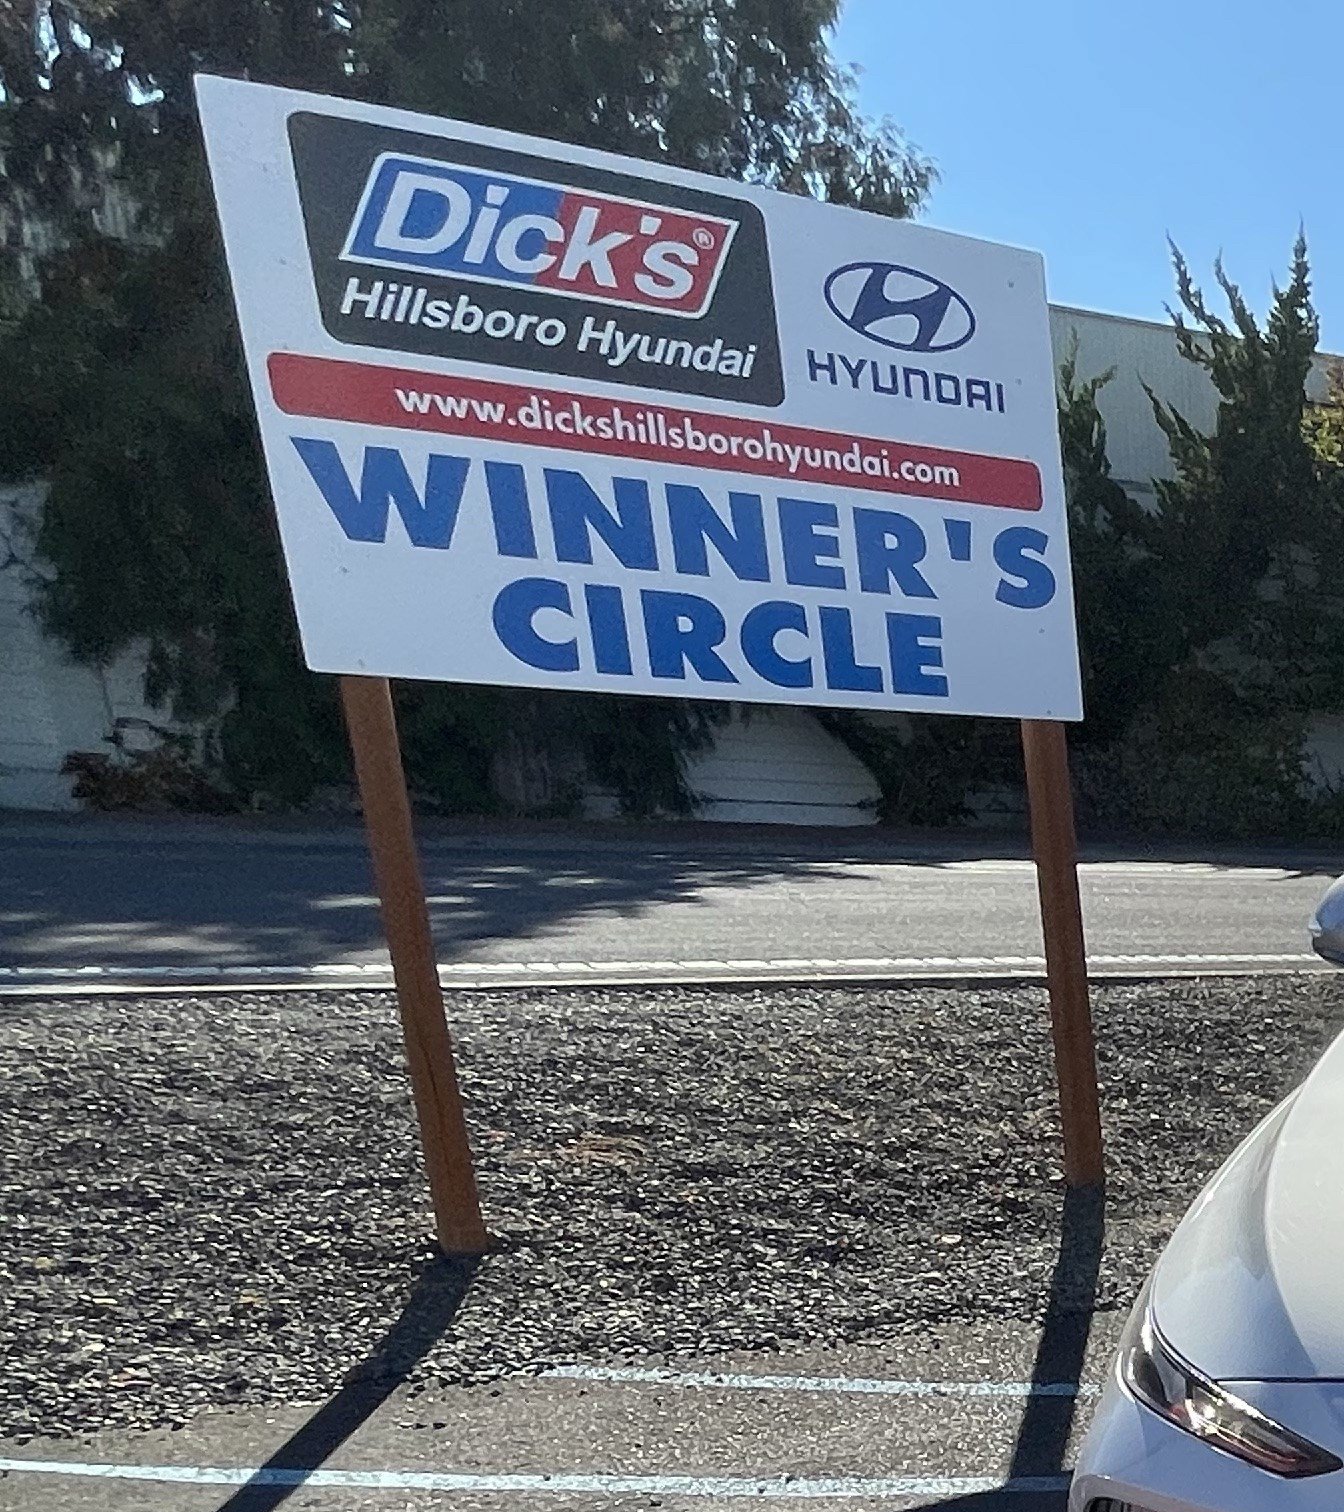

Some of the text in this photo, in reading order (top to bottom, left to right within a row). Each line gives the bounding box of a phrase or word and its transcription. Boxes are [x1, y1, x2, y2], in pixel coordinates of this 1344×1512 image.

[340, 277, 758, 379] Hillsboro Hyundai
[807, 349, 1005, 413] HYUNDAI
[395, 388, 961, 487] www.dickshillsborohyundai.com
[290, 437, 1058, 610] WINNER'S
[490, 577, 951, 698] CIRCLE
